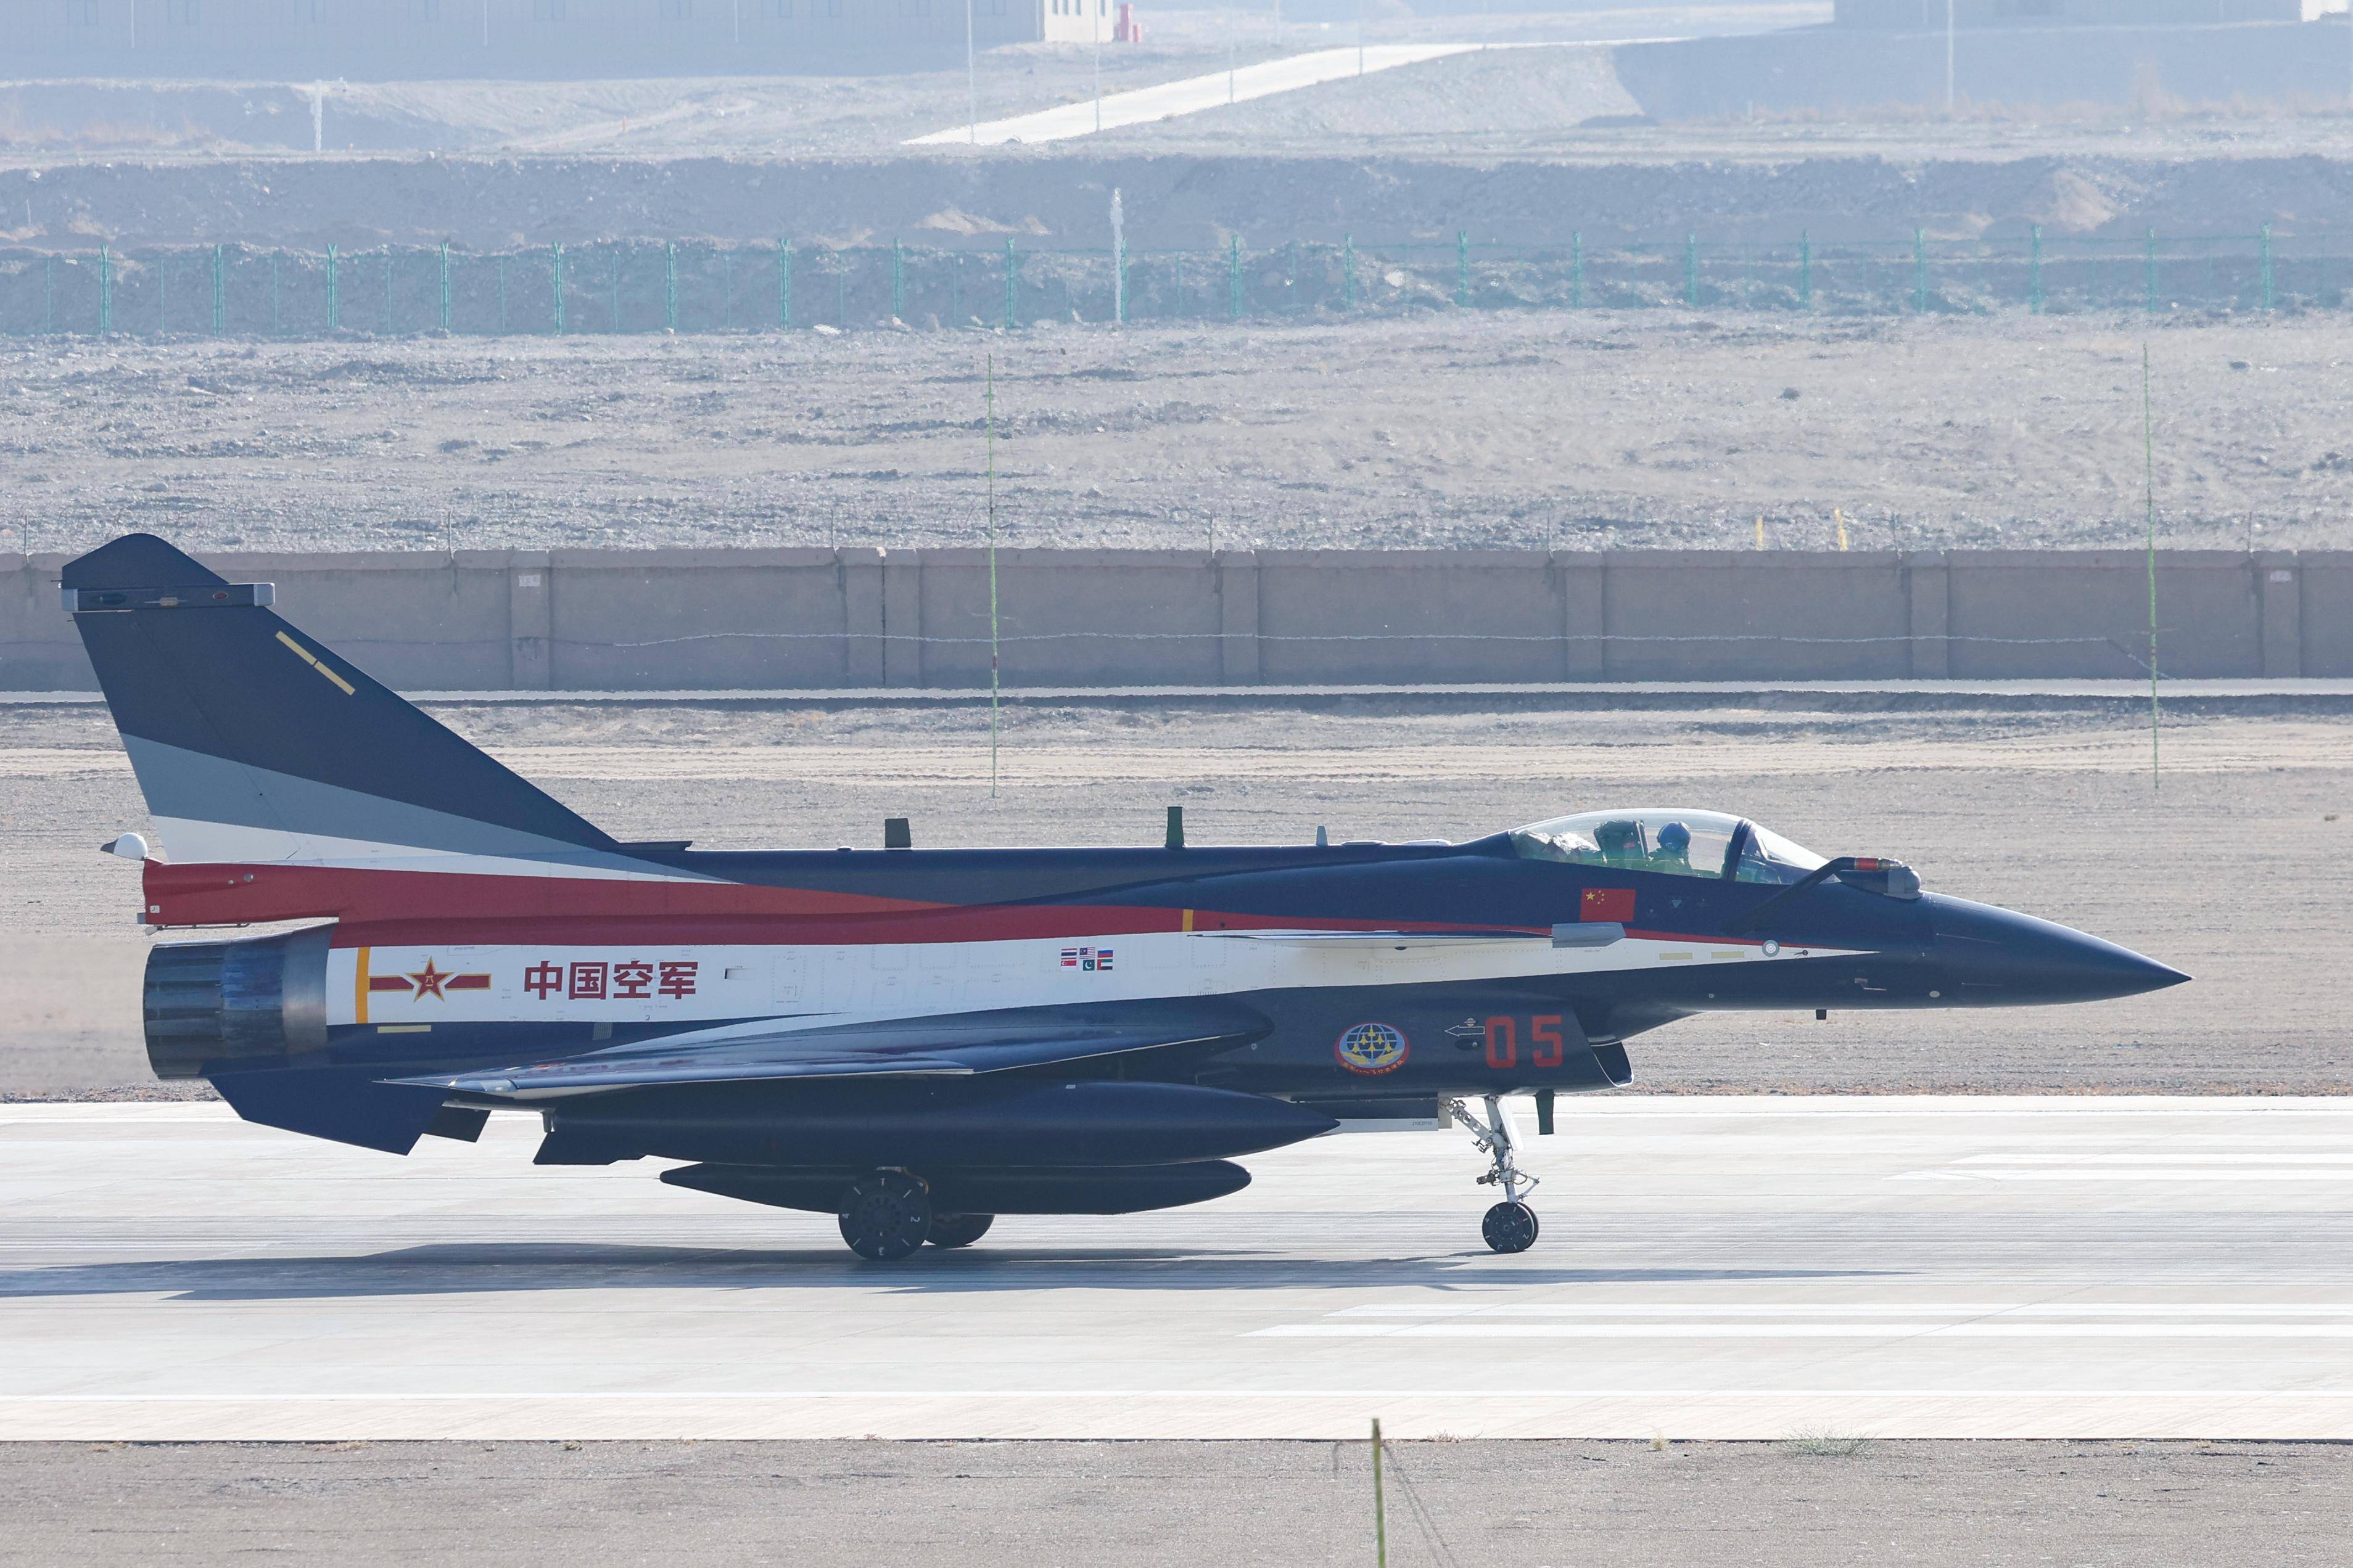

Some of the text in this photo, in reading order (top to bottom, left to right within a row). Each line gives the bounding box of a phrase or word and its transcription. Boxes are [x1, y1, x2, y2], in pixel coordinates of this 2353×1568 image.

[524, 960, 698, 1000] 中国空军
[1486, 1016, 1562, 1069] 05
[880, 1178, 885, 1186] 1
[878, 1247, 884, 1256] 3
